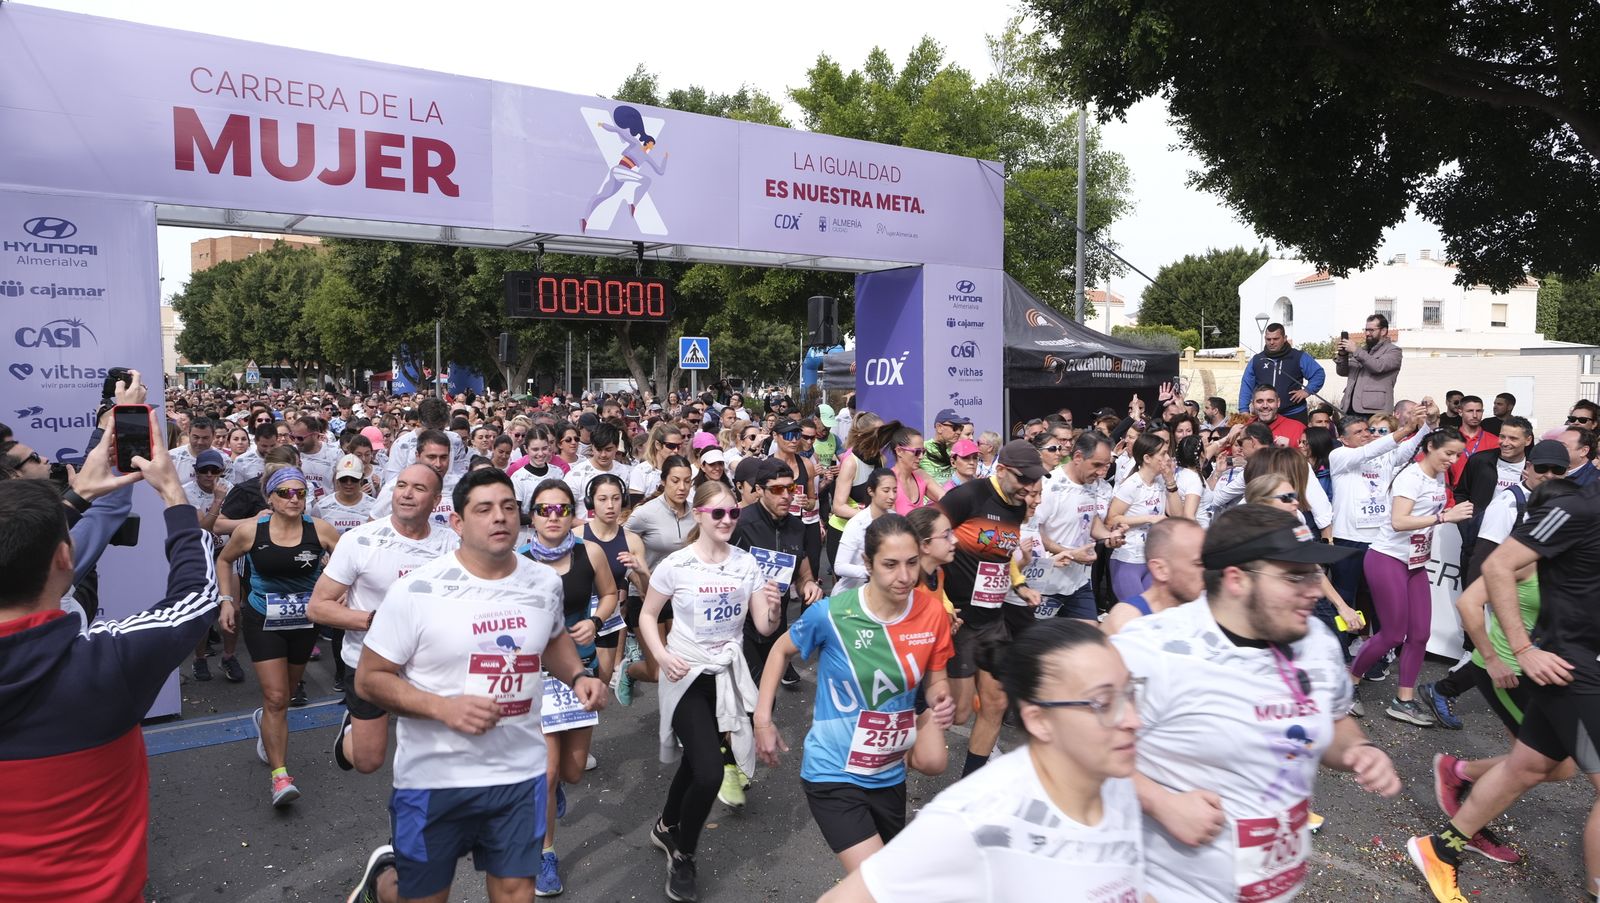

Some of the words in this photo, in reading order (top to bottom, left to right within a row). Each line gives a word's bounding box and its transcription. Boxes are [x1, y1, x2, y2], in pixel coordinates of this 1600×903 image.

[190, 66, 349, 112] CARRERA
[359, 90, 398, 119] DE
[409, 97, 443, 125] LA
[173, 106, 460, 197] MUJER
[794, 152, 815, 172] LA
[820, 155, 901, 183] IGUALDAD
[765, 179, 788, 198] ES
[793, 182, 873, 208] NUESTRA
[876, 192, 925, 214] META.
[774, 213, 803, 230] CDX
[832, 218, 862, 228] ALMERÍA
[4, 241, 97, 255] HYUNDAI
[17, 255, 88, 267] Almerialva
[30, 283, 105, 299] cajamar
[538, 277, 664, 316] 00:00:00
[948, 294, 983, 303] HYUNDAI
[957, 319, 984, 328] cajamar
[15, 326, 80, 348] CASI
[951, 344, 975, 358] CASI
[40, 364, 108, 379] vithas
[865, 351, 910, 386] CDX
[958, 367, 984, 377] vithas
[953, 396, 983, 408] aqualia
[30, 411, 97, 432] aquali
[1361, 504, 1386, 515] 1369
[280, 604, 306, 615] 334
[703, 603, 742, 621] 1206
[472, 616, 527, 635] MUJER
[861, 630, 874, 638] 10
[855, 640, 862, 649] 5
[486, 674, 524, 694] 701
[863, 729, 909, 747] 2517
